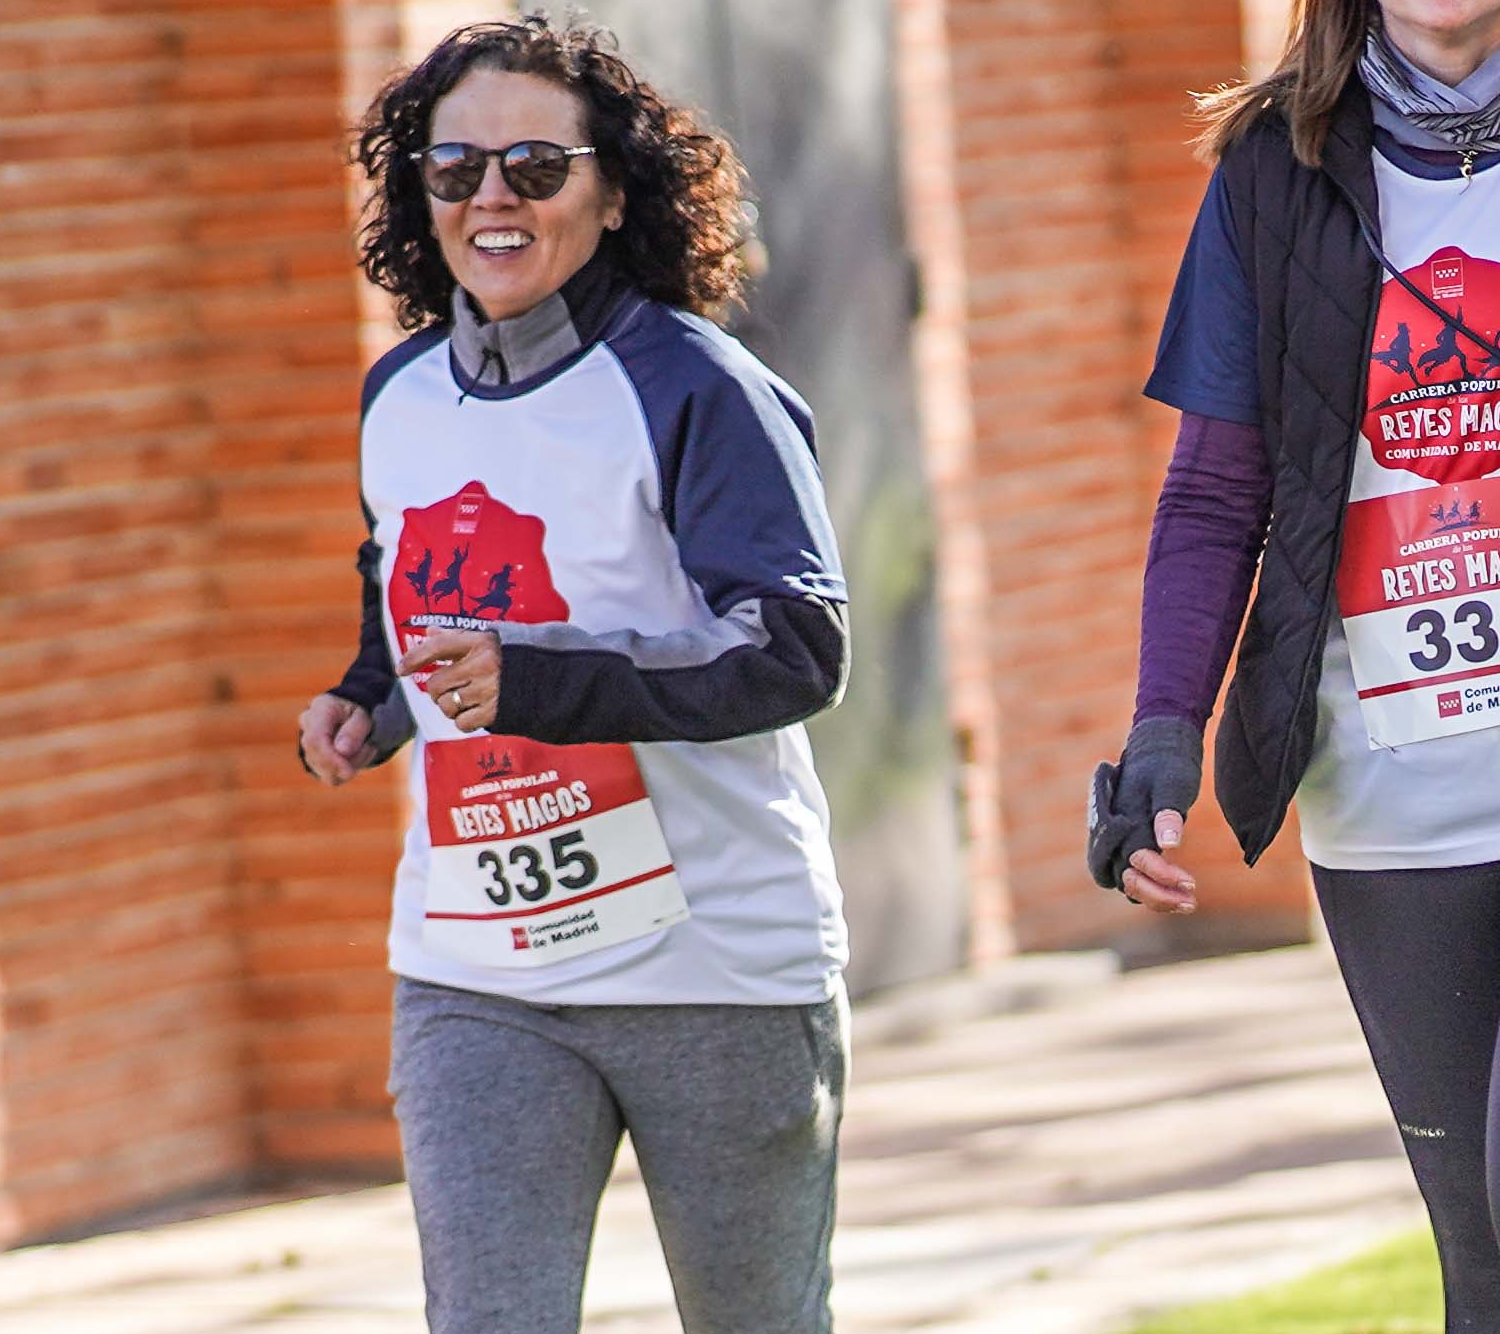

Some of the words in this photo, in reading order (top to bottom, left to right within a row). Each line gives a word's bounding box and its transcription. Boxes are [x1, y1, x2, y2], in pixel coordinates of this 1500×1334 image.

[1390, 383, 1456, 404] CARRERA
[1379, 407, 1453, 442] REYES
[1385, 445, 1460, 460] COMUNIDAD
[1463, 441, 1482, 453] DE
[1400, 533, 1460, 556] CARRERA
[1381, 558, 1457, 602] REYES
[456, 617, 488, 631] POPU
[1466, 702, 1483, 714] de
[501, 769, 559, 791] POPULAR
[451, 803, 506, 840] REYES
[506, 780, 593, 834] MAGOS
[478, 828, 600, 906] 335
[528, 909, 596, 935] Comunidad
[551, 921, 600, 945] Madrid
